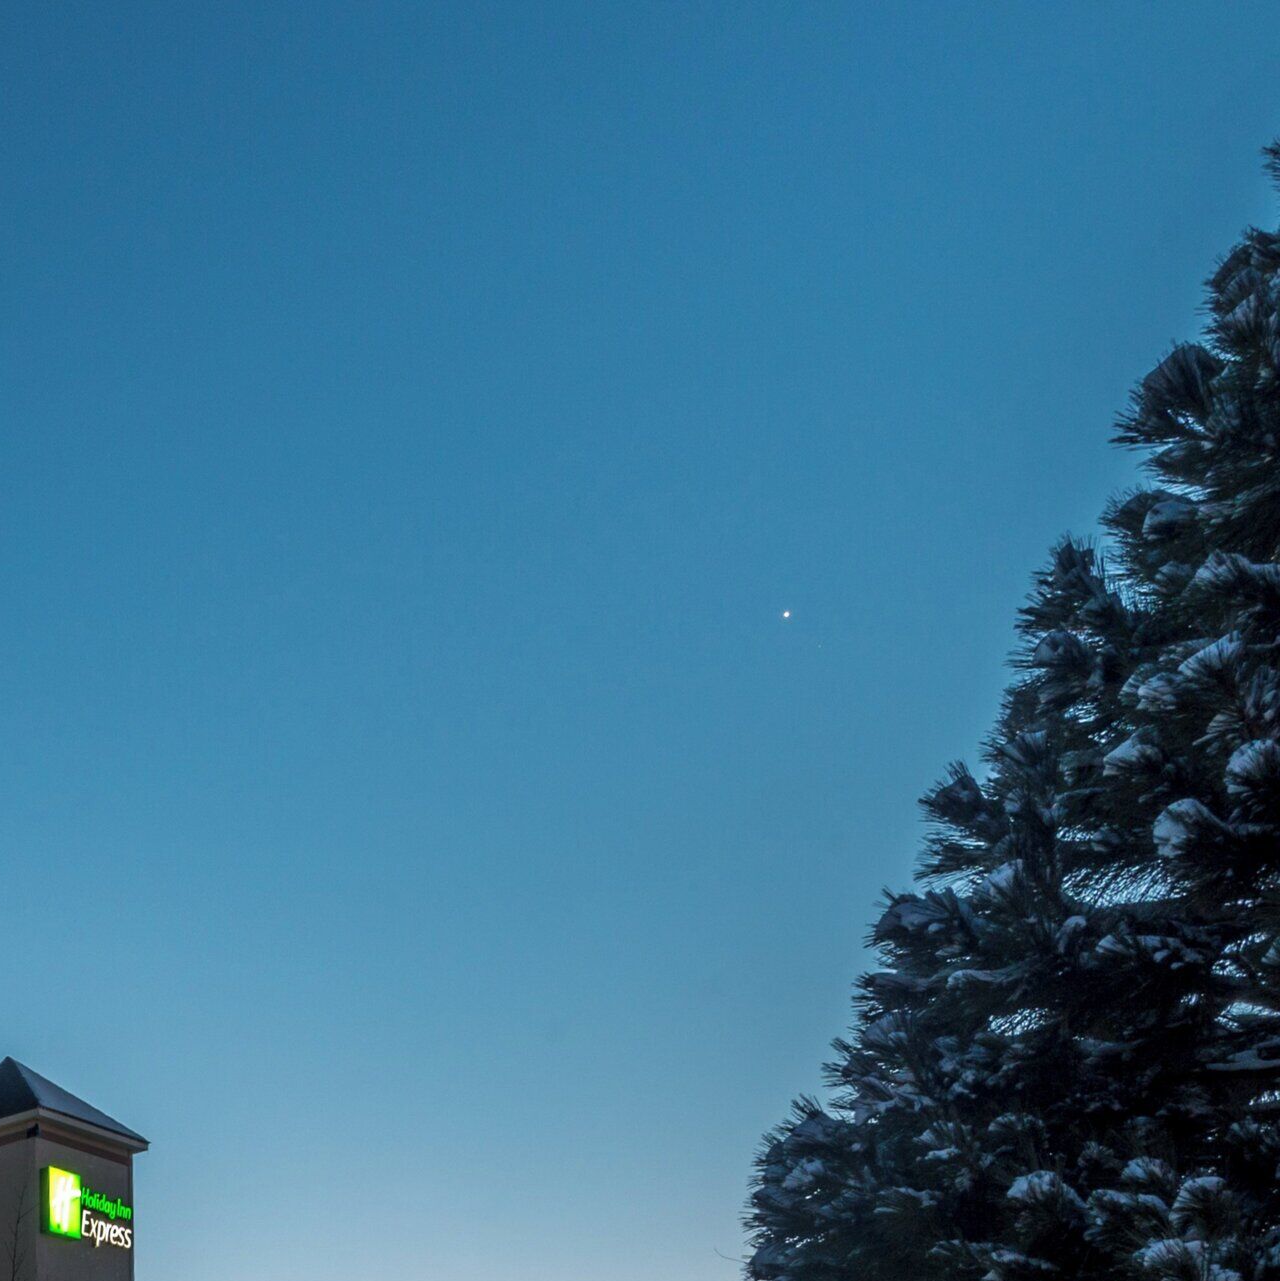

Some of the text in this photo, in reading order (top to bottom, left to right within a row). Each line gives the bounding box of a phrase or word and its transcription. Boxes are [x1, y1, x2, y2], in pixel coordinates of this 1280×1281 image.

[81, 1187, 131, 1220] Holiday Inn
[81, 1209, 132, 1248] Express
